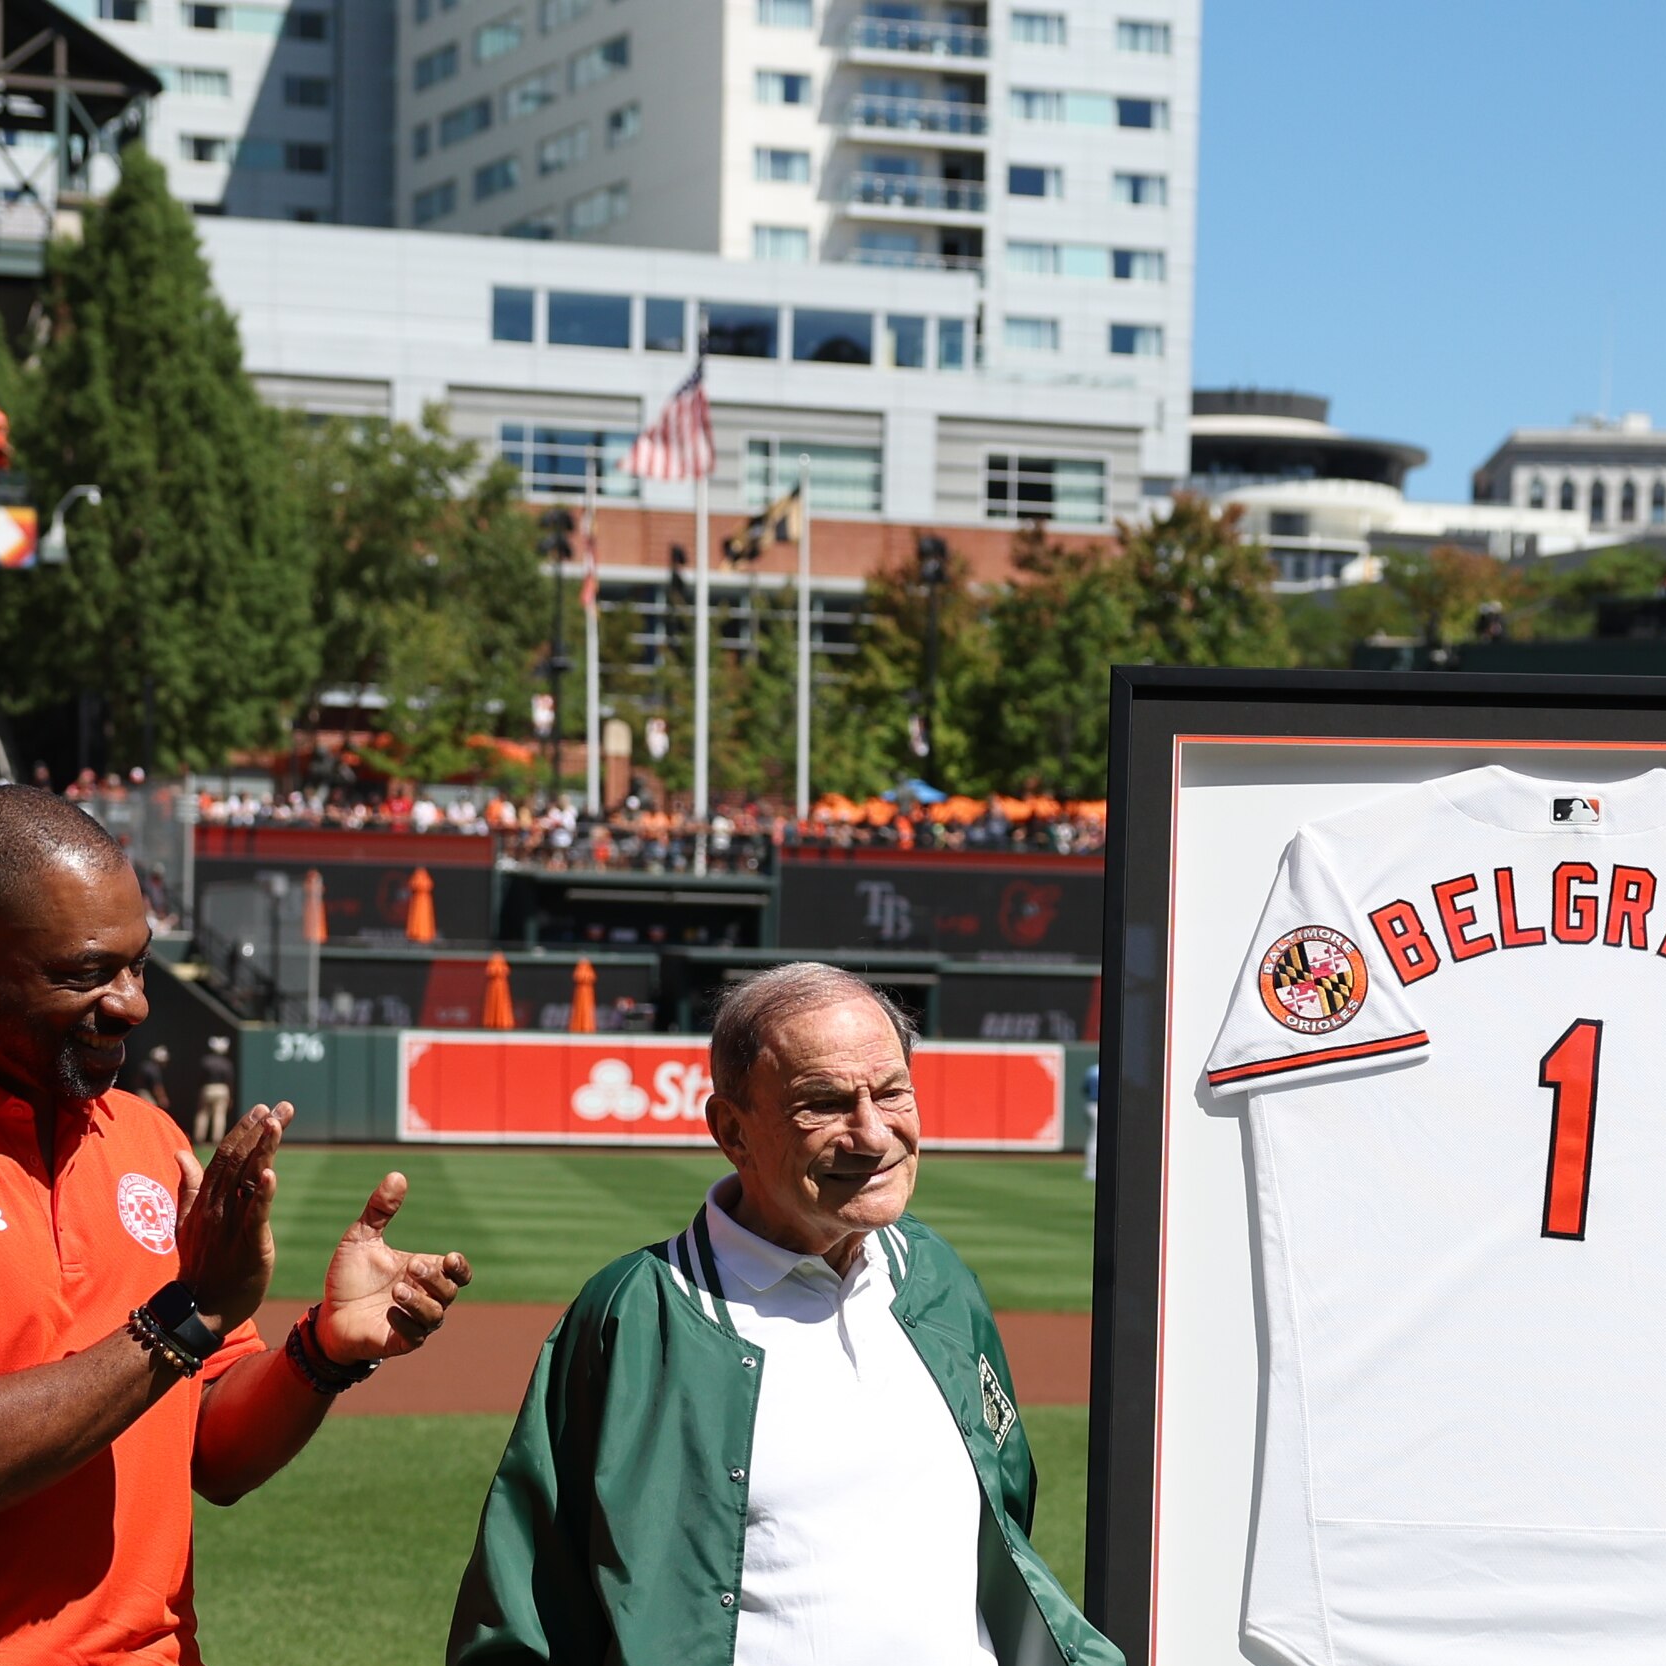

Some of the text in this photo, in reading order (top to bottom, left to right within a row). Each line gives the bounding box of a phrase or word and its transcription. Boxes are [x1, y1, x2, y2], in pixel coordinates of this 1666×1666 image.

[1263, 927, 1355, 974] BALTIMORE
[1285, 1000, 1359, 1032] ORIOLES
[274, 1031, 325, 1062] 376
[1538, 1017, 1603, 1242] 1
